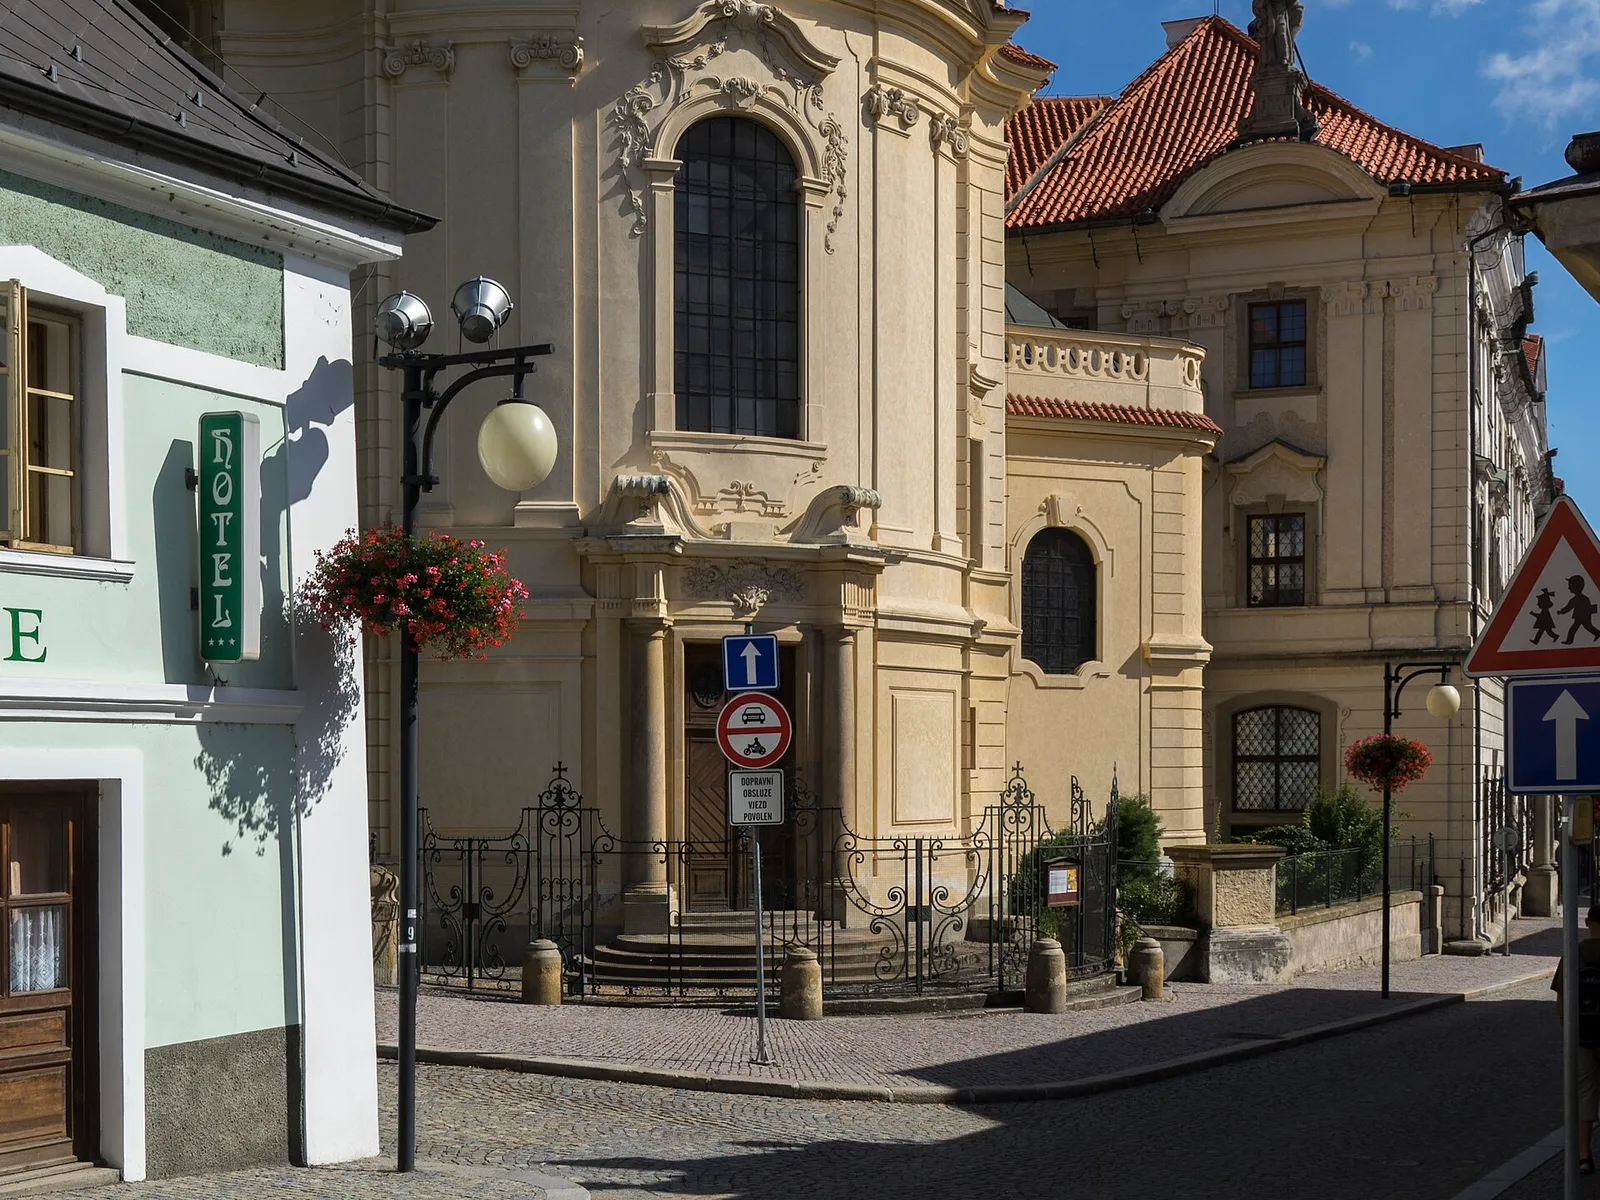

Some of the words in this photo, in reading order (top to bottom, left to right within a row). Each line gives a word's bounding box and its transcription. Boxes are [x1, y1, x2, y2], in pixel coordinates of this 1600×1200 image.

[211, 428, 234, 628] HOTEL
[741, 775, 774, 786] DOPRAVNÍ
[743, 789, 772, 798] OBSLUZE
[748, 801, 768, 809] VJEZD
[743, 812, 773, 821] POVOLEN
